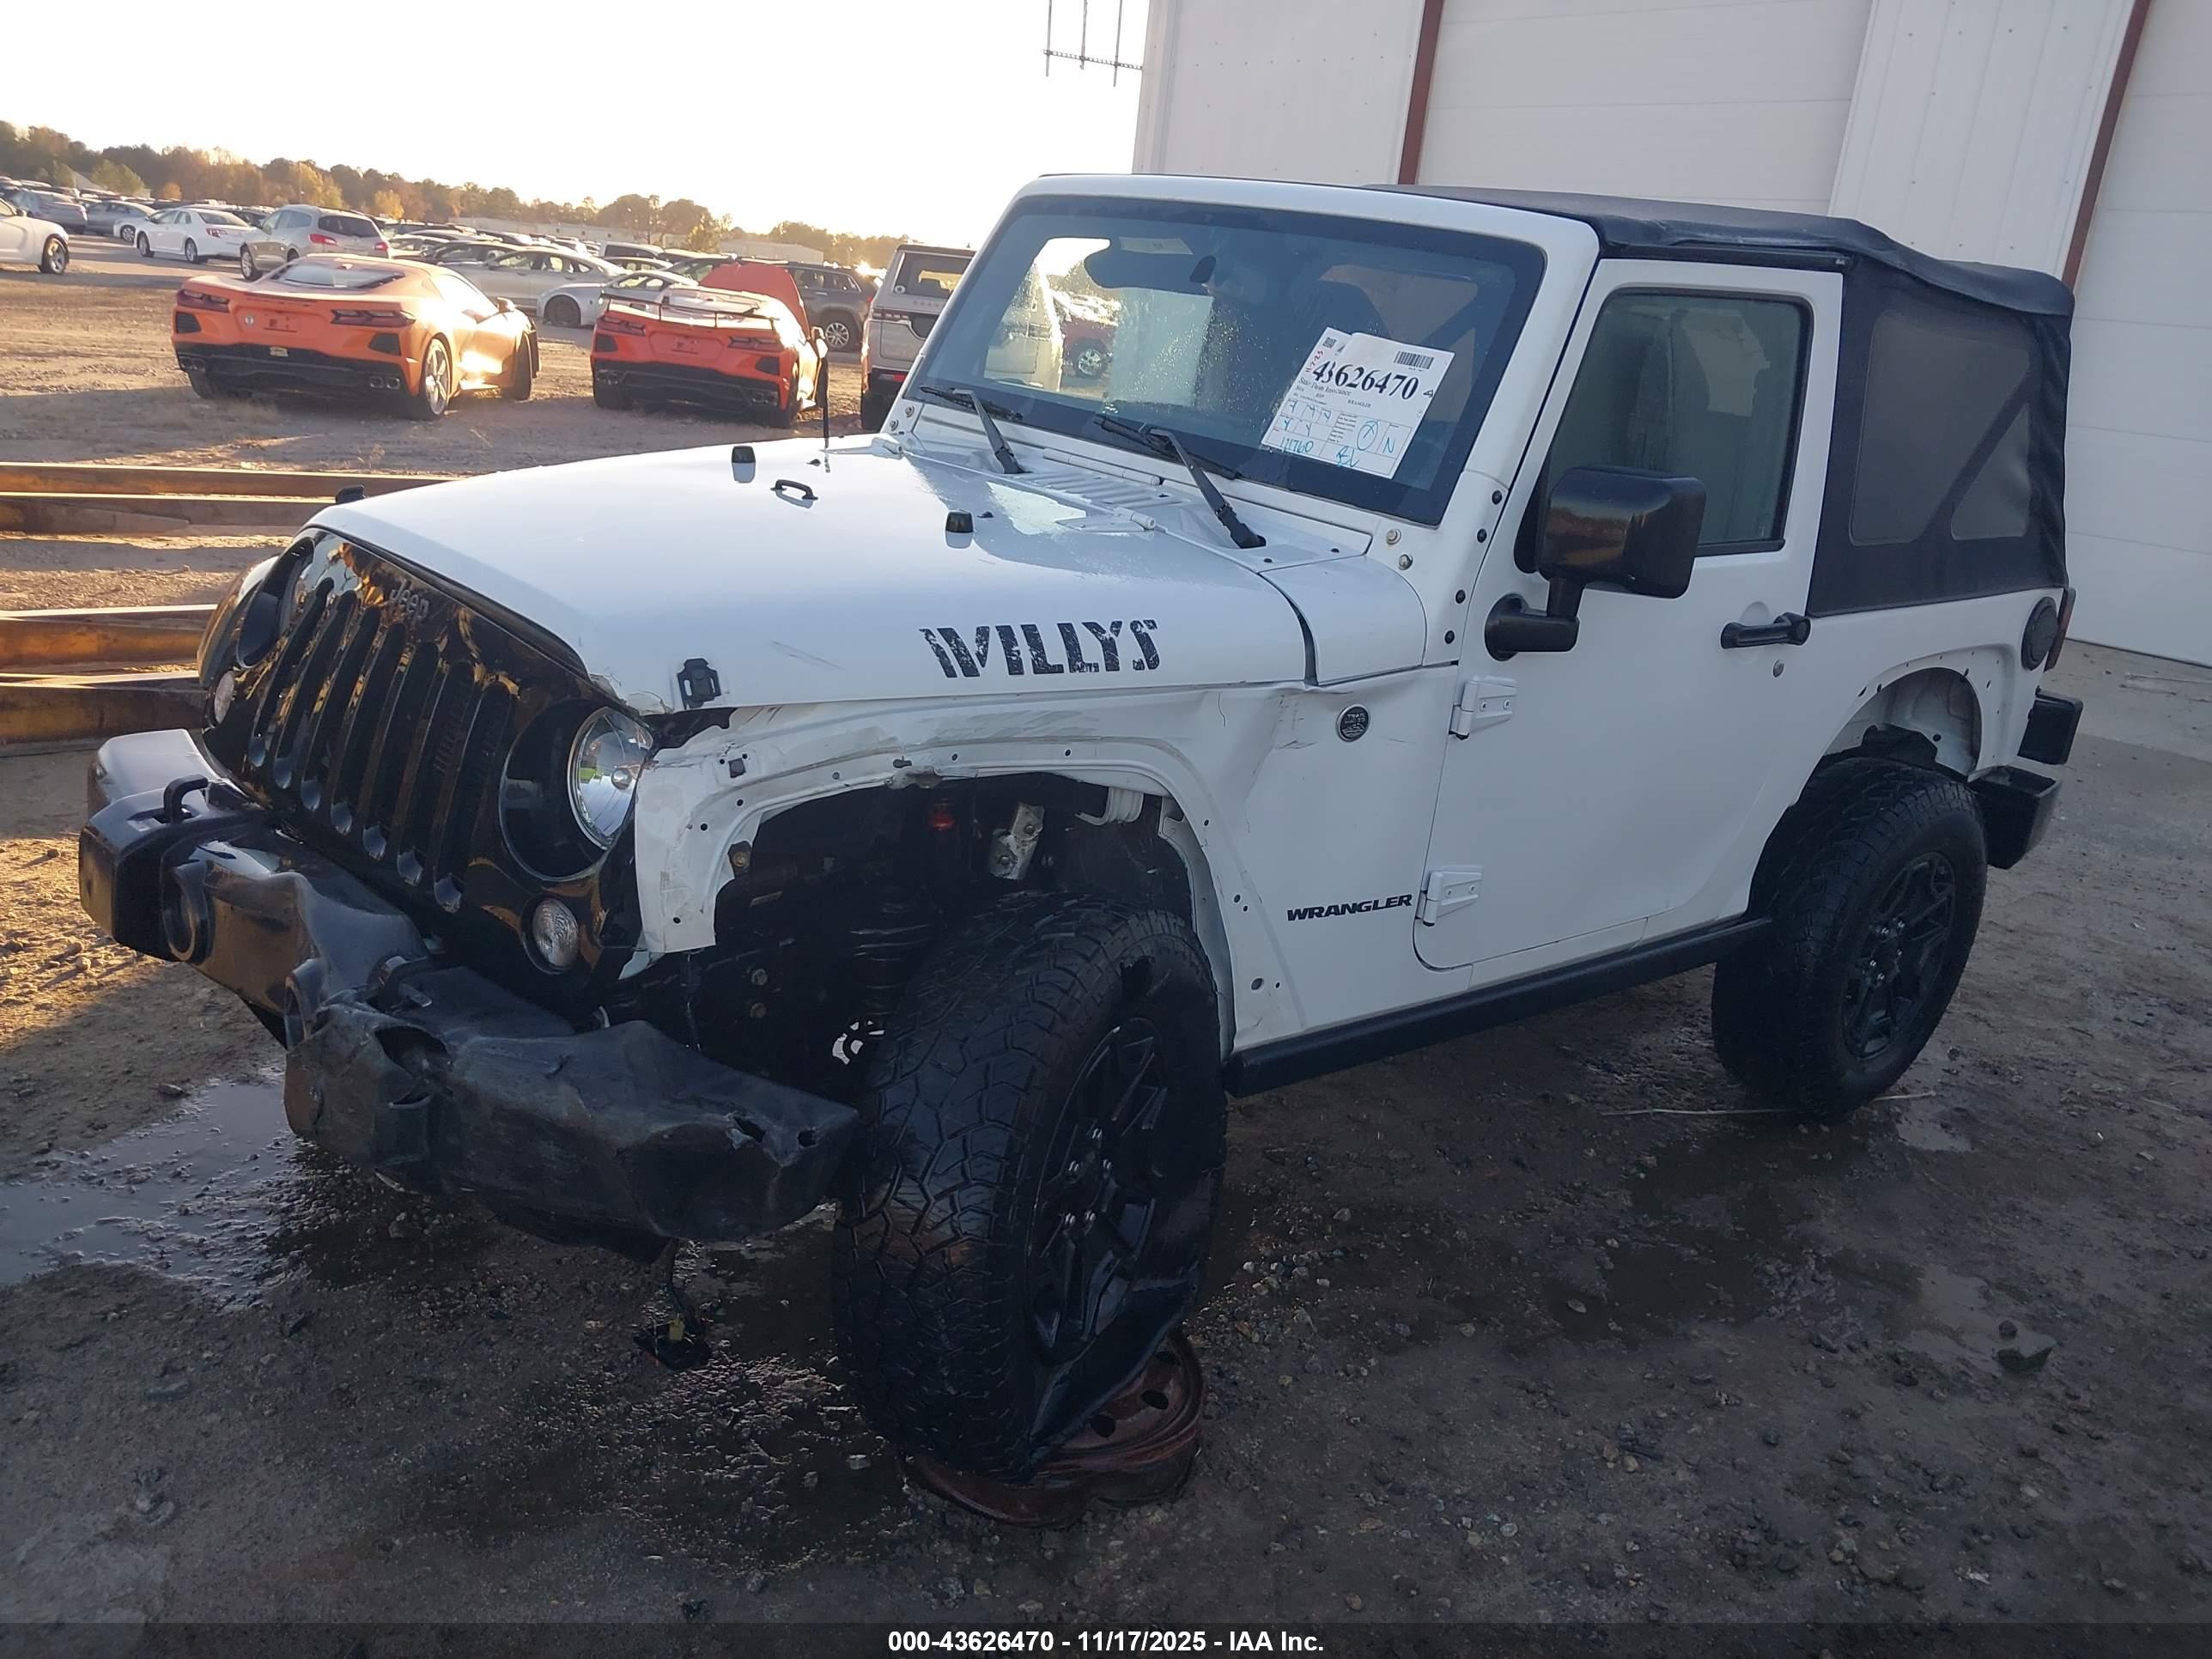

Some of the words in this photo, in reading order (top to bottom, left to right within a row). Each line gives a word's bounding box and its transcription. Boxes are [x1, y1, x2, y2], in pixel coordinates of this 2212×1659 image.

[1312, 360, 1419, 401] 43626470
[919, 619, 1160, 678] WILLYS
[1286, 894, 1413, 921] WRANGLER
